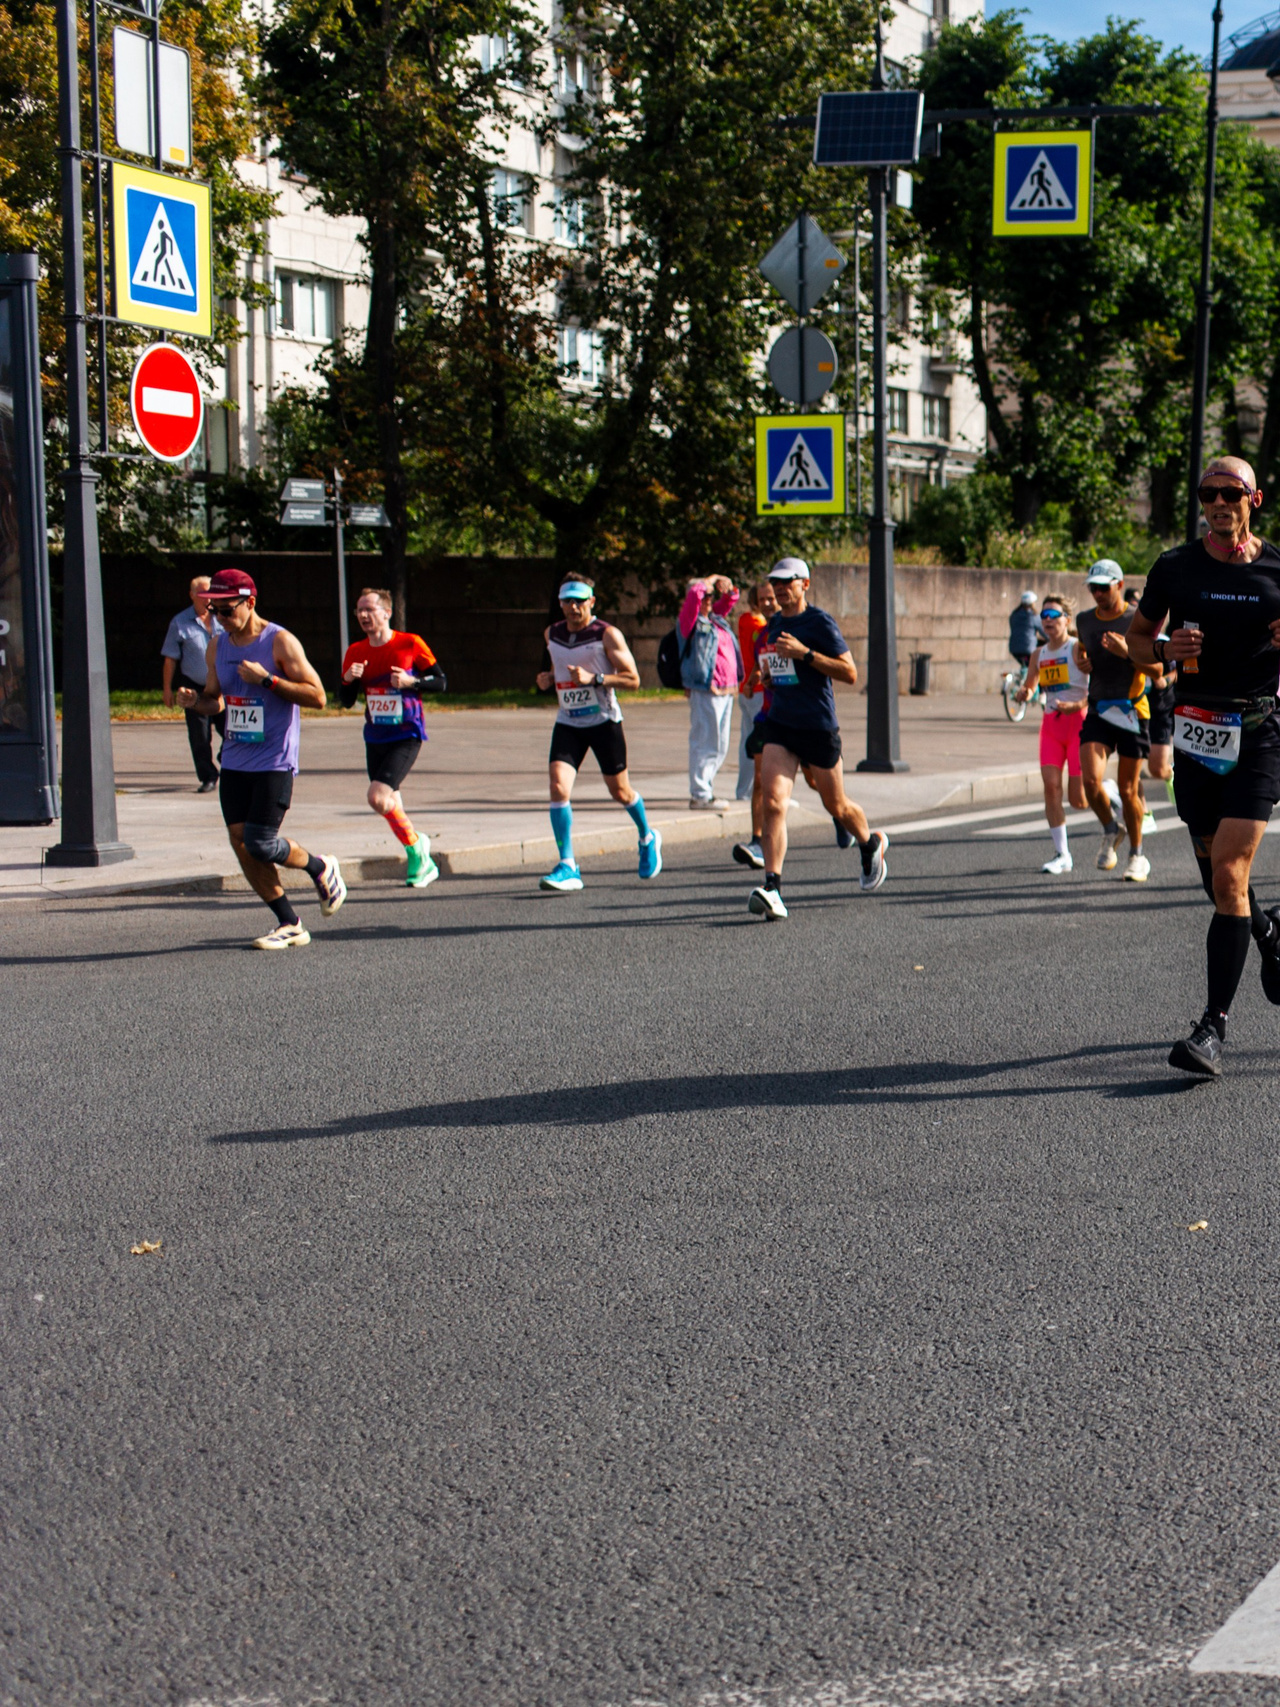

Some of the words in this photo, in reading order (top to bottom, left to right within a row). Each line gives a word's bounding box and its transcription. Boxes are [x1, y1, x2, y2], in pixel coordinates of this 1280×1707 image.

[1210, 593, 1236, 601] UNDER
[1045, 667, 1061, 680] 171
[563, 689, 592, 703] 6922
[369, 700, 397, 712] 7267
[231, 709, 258, 723] 1714
[1182, 721, 1232, 748] 2937
[1190, 743, 1220, 755] ЕВГЕНИЙ
